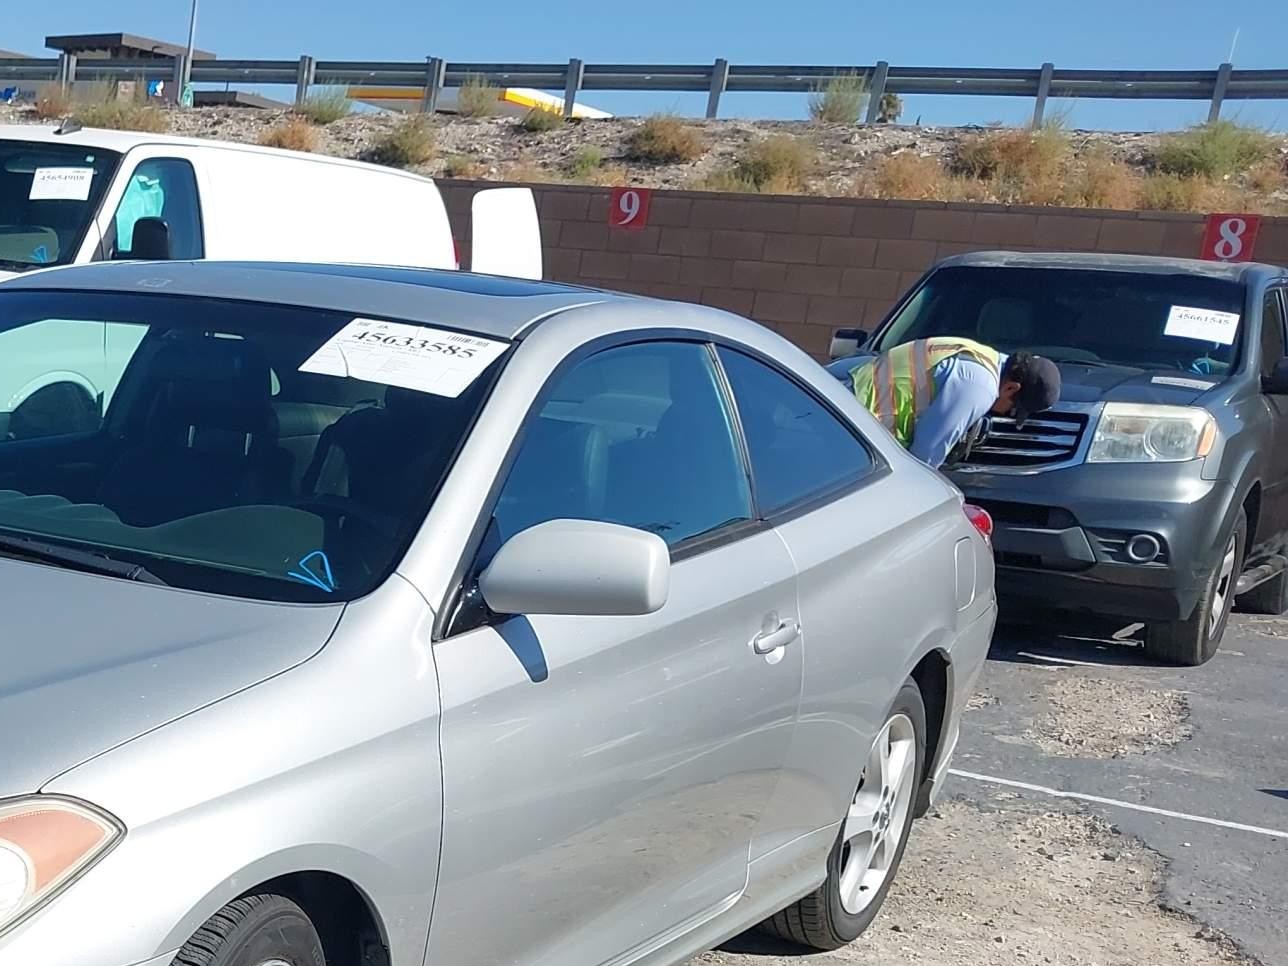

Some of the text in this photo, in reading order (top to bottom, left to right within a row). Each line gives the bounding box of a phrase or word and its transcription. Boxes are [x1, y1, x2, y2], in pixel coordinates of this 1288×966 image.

[617, 191, 640, 225] 9
[1214, 218, 1246, 258] 8
[351, 330, 480, 359] 45633585
